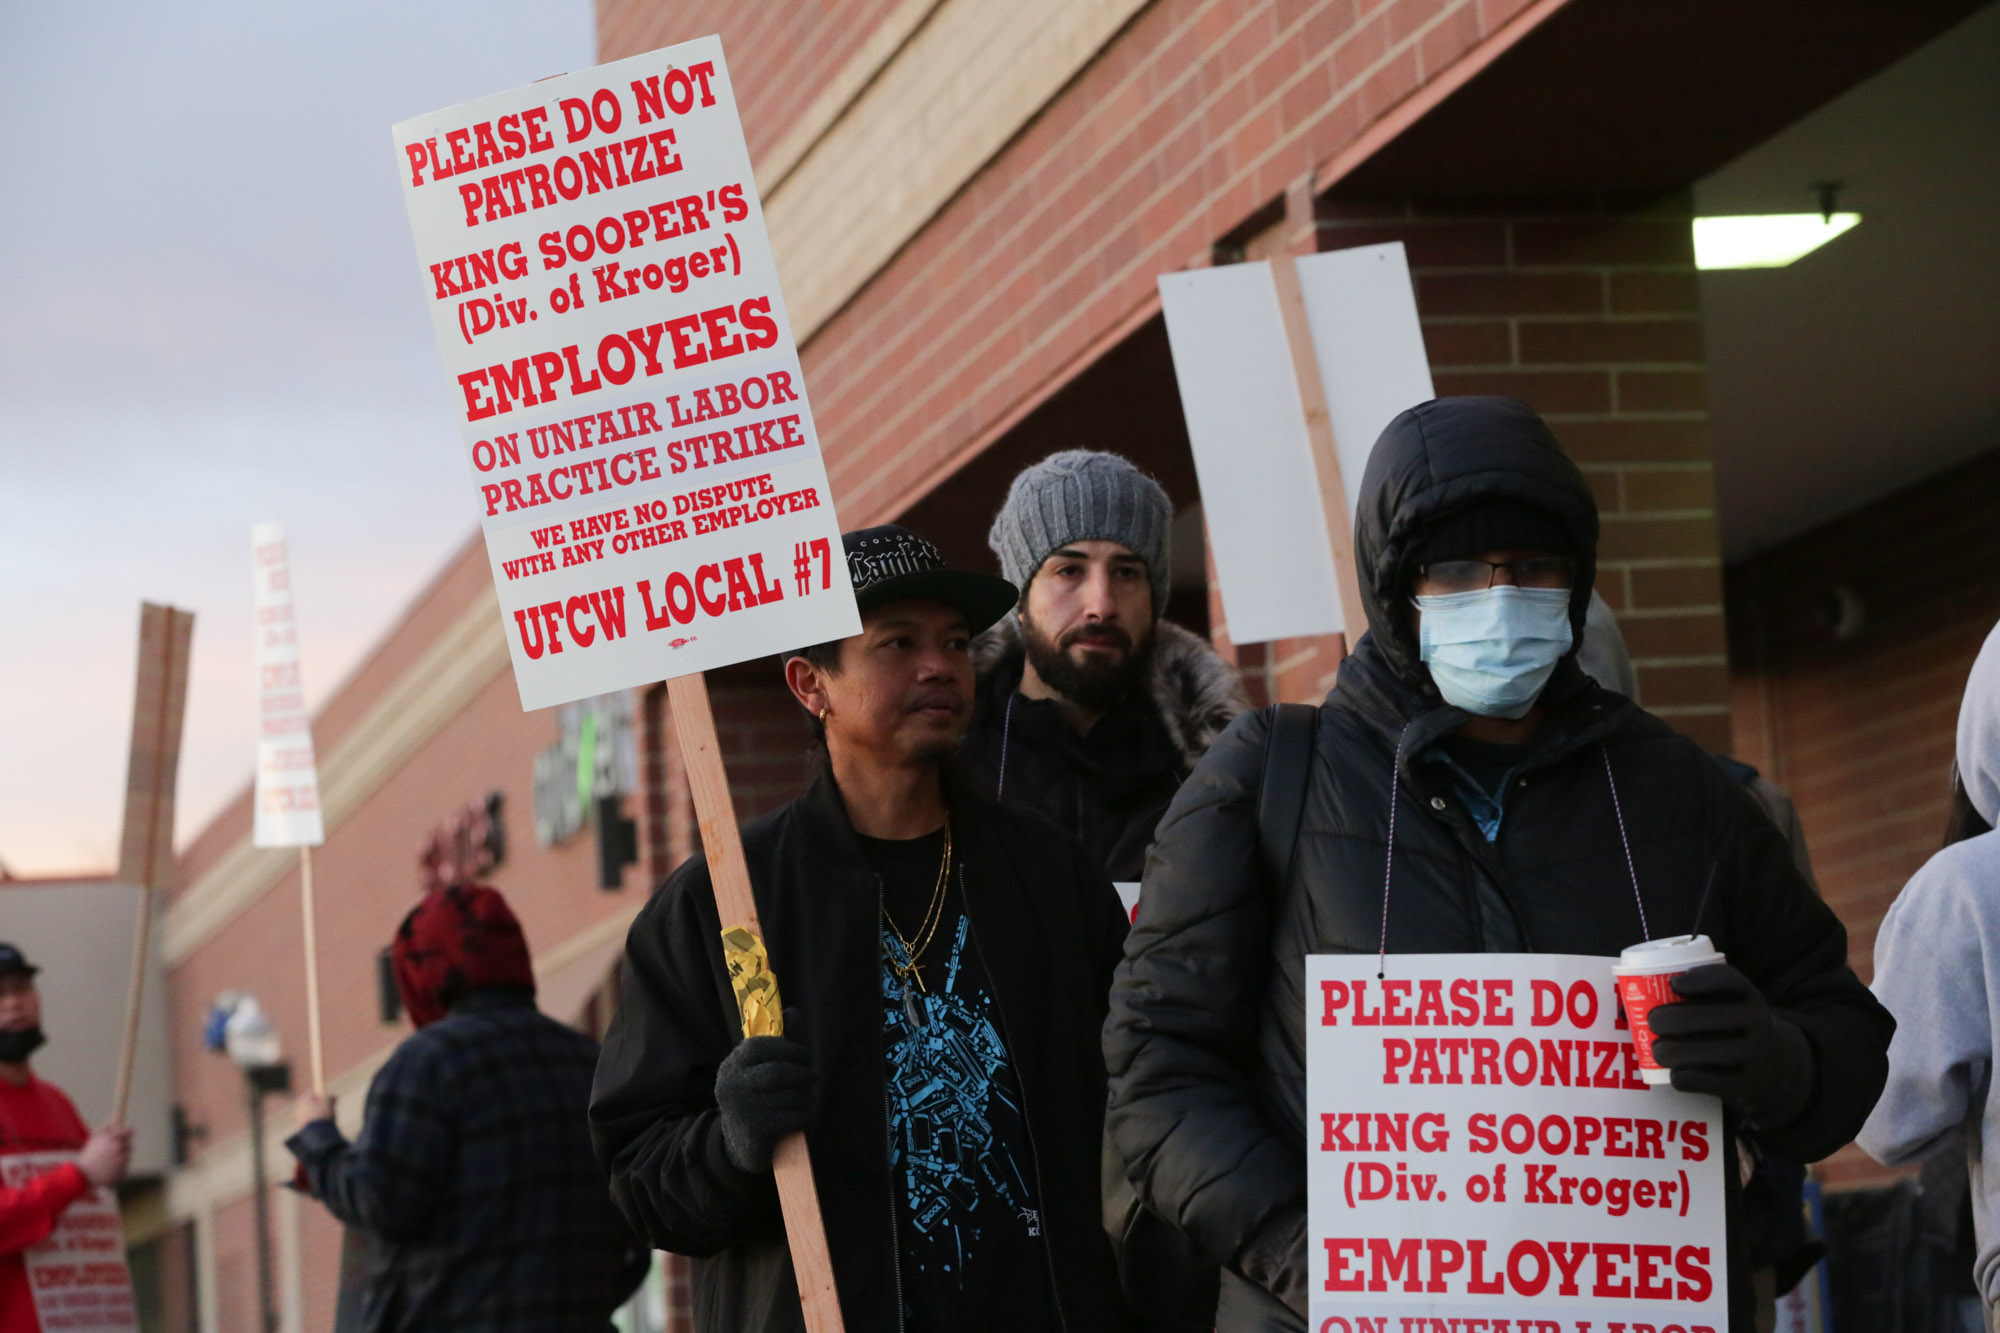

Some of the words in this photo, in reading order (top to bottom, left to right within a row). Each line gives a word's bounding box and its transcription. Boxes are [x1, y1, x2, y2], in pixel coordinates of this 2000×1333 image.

[405, 106, 555, 187] PLEASE
[559, 88, 622, 144] DO
[630, 61, 716, 124] NOT
[459, 128, 683, 227] PATRONIZE
[430, 242, 528, 300] KING
[539, 184, 748, 270] SOOPER'S
[459, 293, 538, 344] (Div.
[550, 273, 584, 314] of
[592, 233, 741, 303] Kroger)
[458, 296, 778, 422] EMPLOYEES
[473, 433, 520, 472] ON
[526, 402, 662, 459] UNFAIR
[666, 371, 798, 428] LABOR
[481, 447, 661, 516] PRACTICE
[667, 414, 805, 474] STRIKE
[502, 551, 556, 580] WITH
[562, 539, 604, 568] ANY
[612, 520, 688, 554] OTHER
[692, 488, 820, 535] EMPLOYER
[531, 524, 566, 549] WE
[569, 509, 630, 541] HAVE
[634, 500, 667, 525] NO
[673, 474, 774, 516] DISPUTE
[514, 586, 626, 660] UFCW
[637, 553, 784, 631] LOCAL
[794, 537, 831, 597] #7
[1321, 979, 1513, 1026] PLEASE
[1531, 980, 1598, 1029] DO
[1321, 1113, 1449, 1152] KING
[1469, 1113, 1709, 1161] SOOPER'S
[1345, 1162, 1446, 1208] (Div.
[1467, 1164, 1506, 1202] of
[1525, 1164, 1689, 1216] Kroger)
[1324, 1238, 1712, 1302] EMPLOYEES
